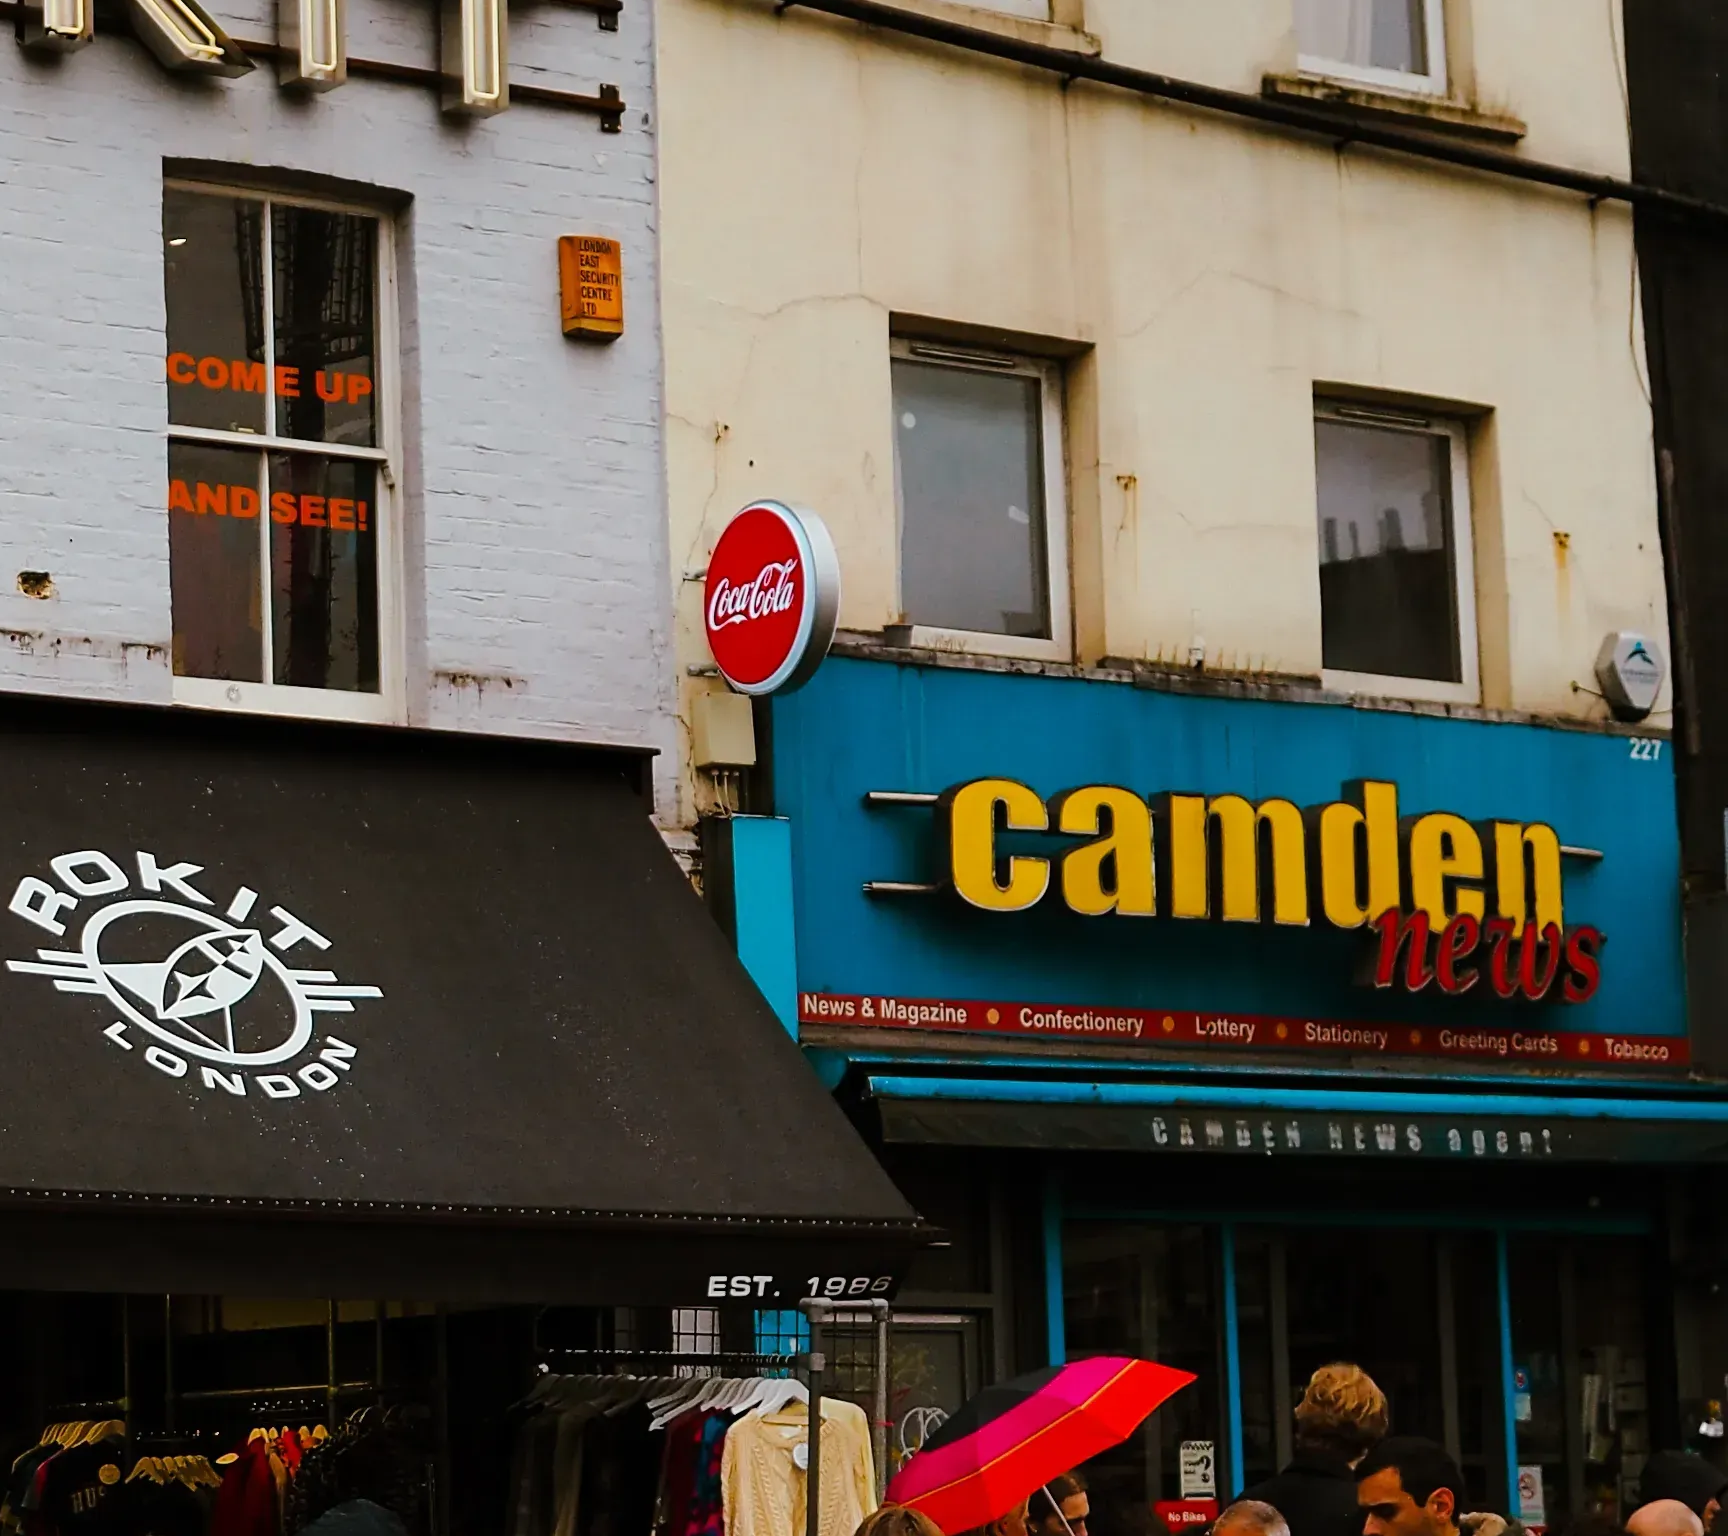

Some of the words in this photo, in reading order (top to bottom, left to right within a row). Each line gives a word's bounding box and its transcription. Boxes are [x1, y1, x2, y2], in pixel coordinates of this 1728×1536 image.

[579, 239, 612, 254] LONDON
[579, 254, 600, 267] EAST
[580, 270, 620, 287] SECURITY
[581, 285, 613, 302] CENTRE
[581, 301, 597, 315] LTD
[167, 352, 301, 398] COME
[316, 370, 374, 405] UP
[168, 480, 260, 519] AND
[272, 492, 368, 531] SEE!
[709, 558, 799, 631] Coca-Cola
[1628, 737, 1663, 761] 227
[940, 777, 1566, 940] camden
[8, 850, 333, 951] ROKIT
[1370, 906, 1607, 1005] news
[803, 994, 856, 1017] News
[862, 997, 876, 1019] &
[880, 999, 967, 1025] Magazine
[1019, 1008, 1144, 1037] Confectionery
[1196, 1016, 1256, 1043] Lottery
[1304, 1022, 1389, 1050] Stationery
[1439, 1029, 1508, 1055] Greeting
[1511, 1032, 1558, 1054] Cards
[1604, 1037, 1670, 1062] Tobacco
[103, 1020, 357, 1099] LONDON
[1150, 1116, 1302, 1149] CAMDEN
[1328, 1122, 1424, 1152] NEWS
[708, 1275, 781, 1298] EST.
[807, 1275, 892, 1298] 1986
[1167, 1511, 1181, 1522] No
[1182, 1511, 1207, 1522] Bikes
